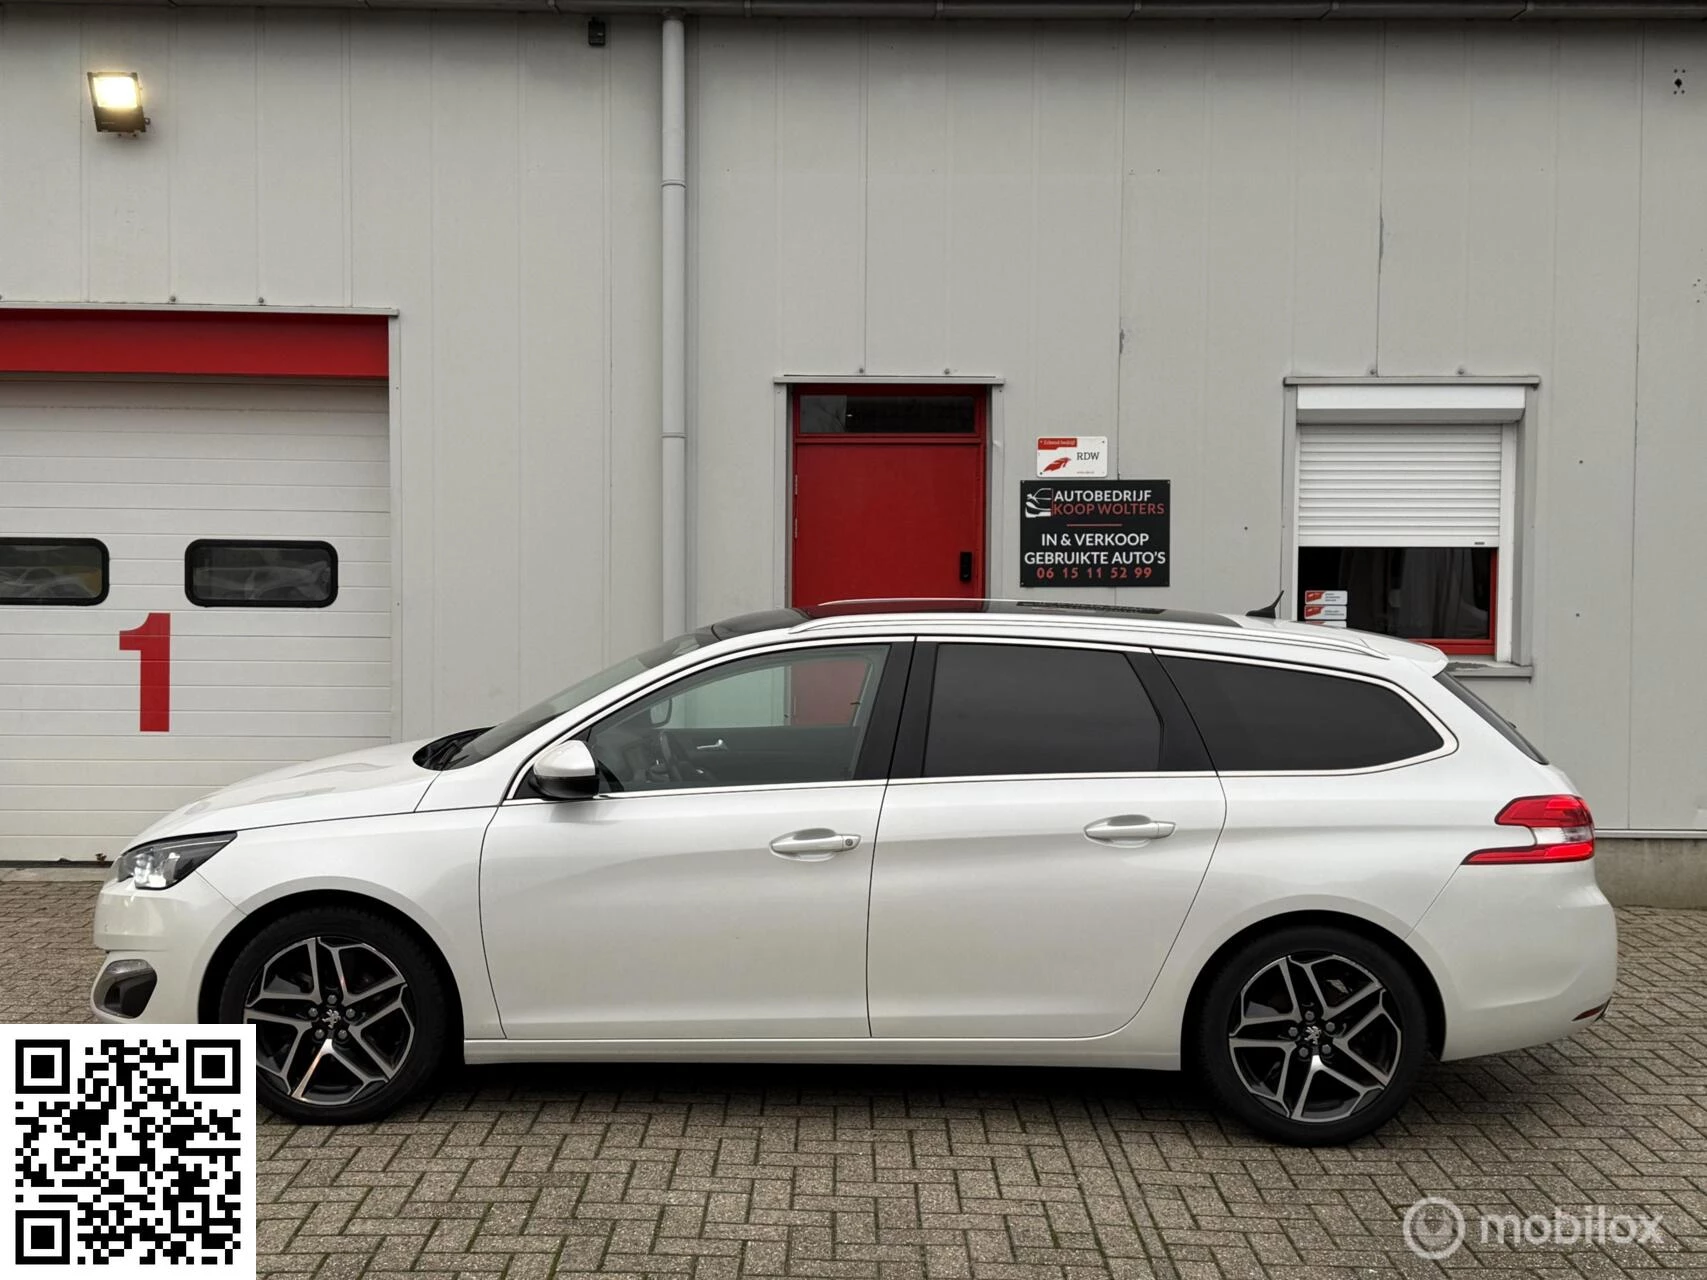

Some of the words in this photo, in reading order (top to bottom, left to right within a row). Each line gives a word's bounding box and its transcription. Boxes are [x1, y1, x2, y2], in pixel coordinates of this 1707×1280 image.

[1076, 452, 1100, 460] RDW
[1054, 490, 1152, 502] AUTOBEDRIJF
[1053, 503, 1095, 514] KOOP
[1098, 503, 1165, 514] WOLTERS
[1041, 533, 1057, 546] IN
[1060, 533, 1071, 546] &
[1074, 533, 1149, 546] VERKOOP
[1024, 551, 1109, 564] GEBRUIKTE
[1111, 551, 1166, 564] AUTO'S
[1036, 568, 1054, 579] 06
[1063, 568, 1078, 579] 15
[1087, 568, 1102, 579] 11
[1111, 568, 1127, 579] 52
[1134, 568, 1152, 579] 99
[119, 613, 170, 731] 1
